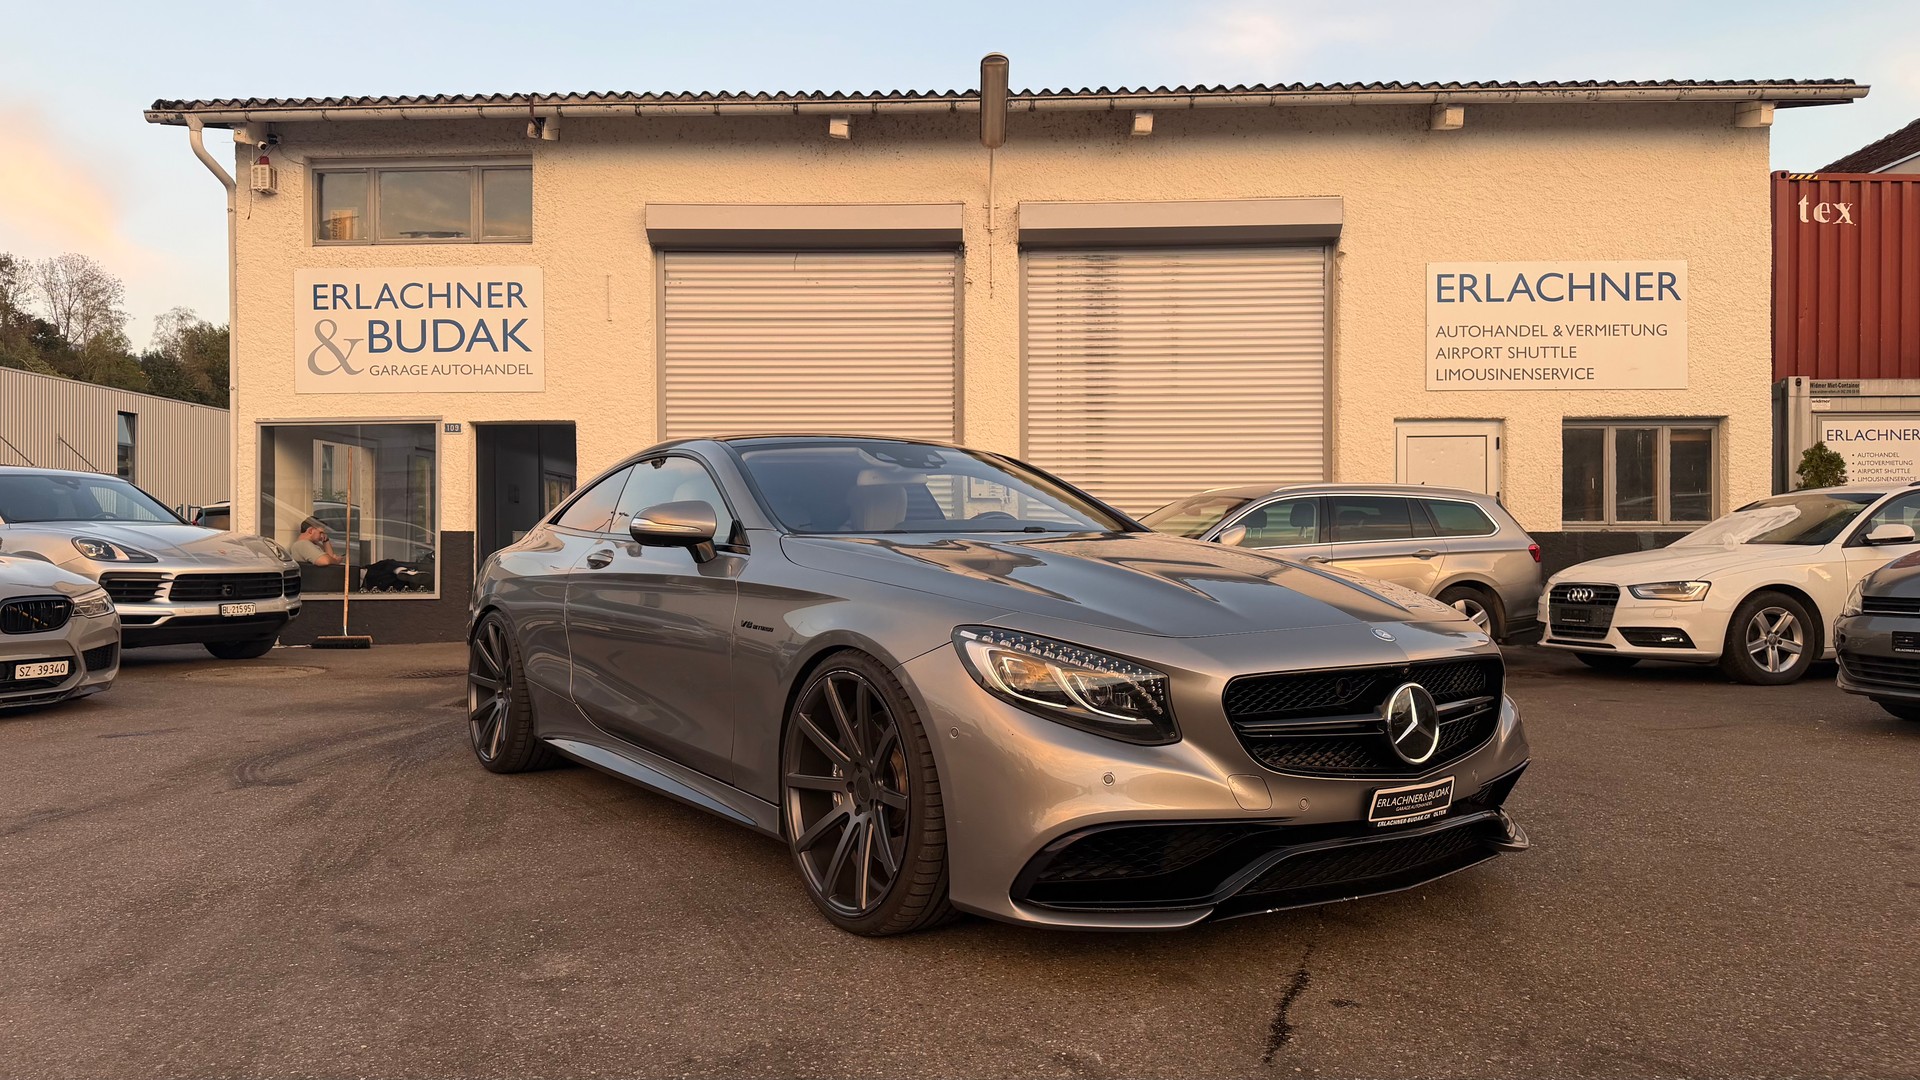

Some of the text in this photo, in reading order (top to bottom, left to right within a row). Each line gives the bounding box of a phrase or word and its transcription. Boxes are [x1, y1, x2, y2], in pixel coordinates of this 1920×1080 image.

[1436, 271, 1682, 303] ERLACHNER
[312, 282, 528, 310] ERLACHNER
[1435, 323, 1669, 338] AUTOHANDEL & VERMIETUNG
[307, 318, 533, 376] & BUDAK
[1435, 345, 1578, 360] AIRPORT SHUTTLE
[369, 363, 534, 376] GARAGE AUTOHANDEL
[1435, 367, 1596, 381] LIMOUSINENSERVICE
[446, 424, 460, 432] 109
[1826, 429, 1920, 441] ERLACHNER
[741, 620, 753, 628] V8
[1432, 809, 1447, 818] OLTEN
